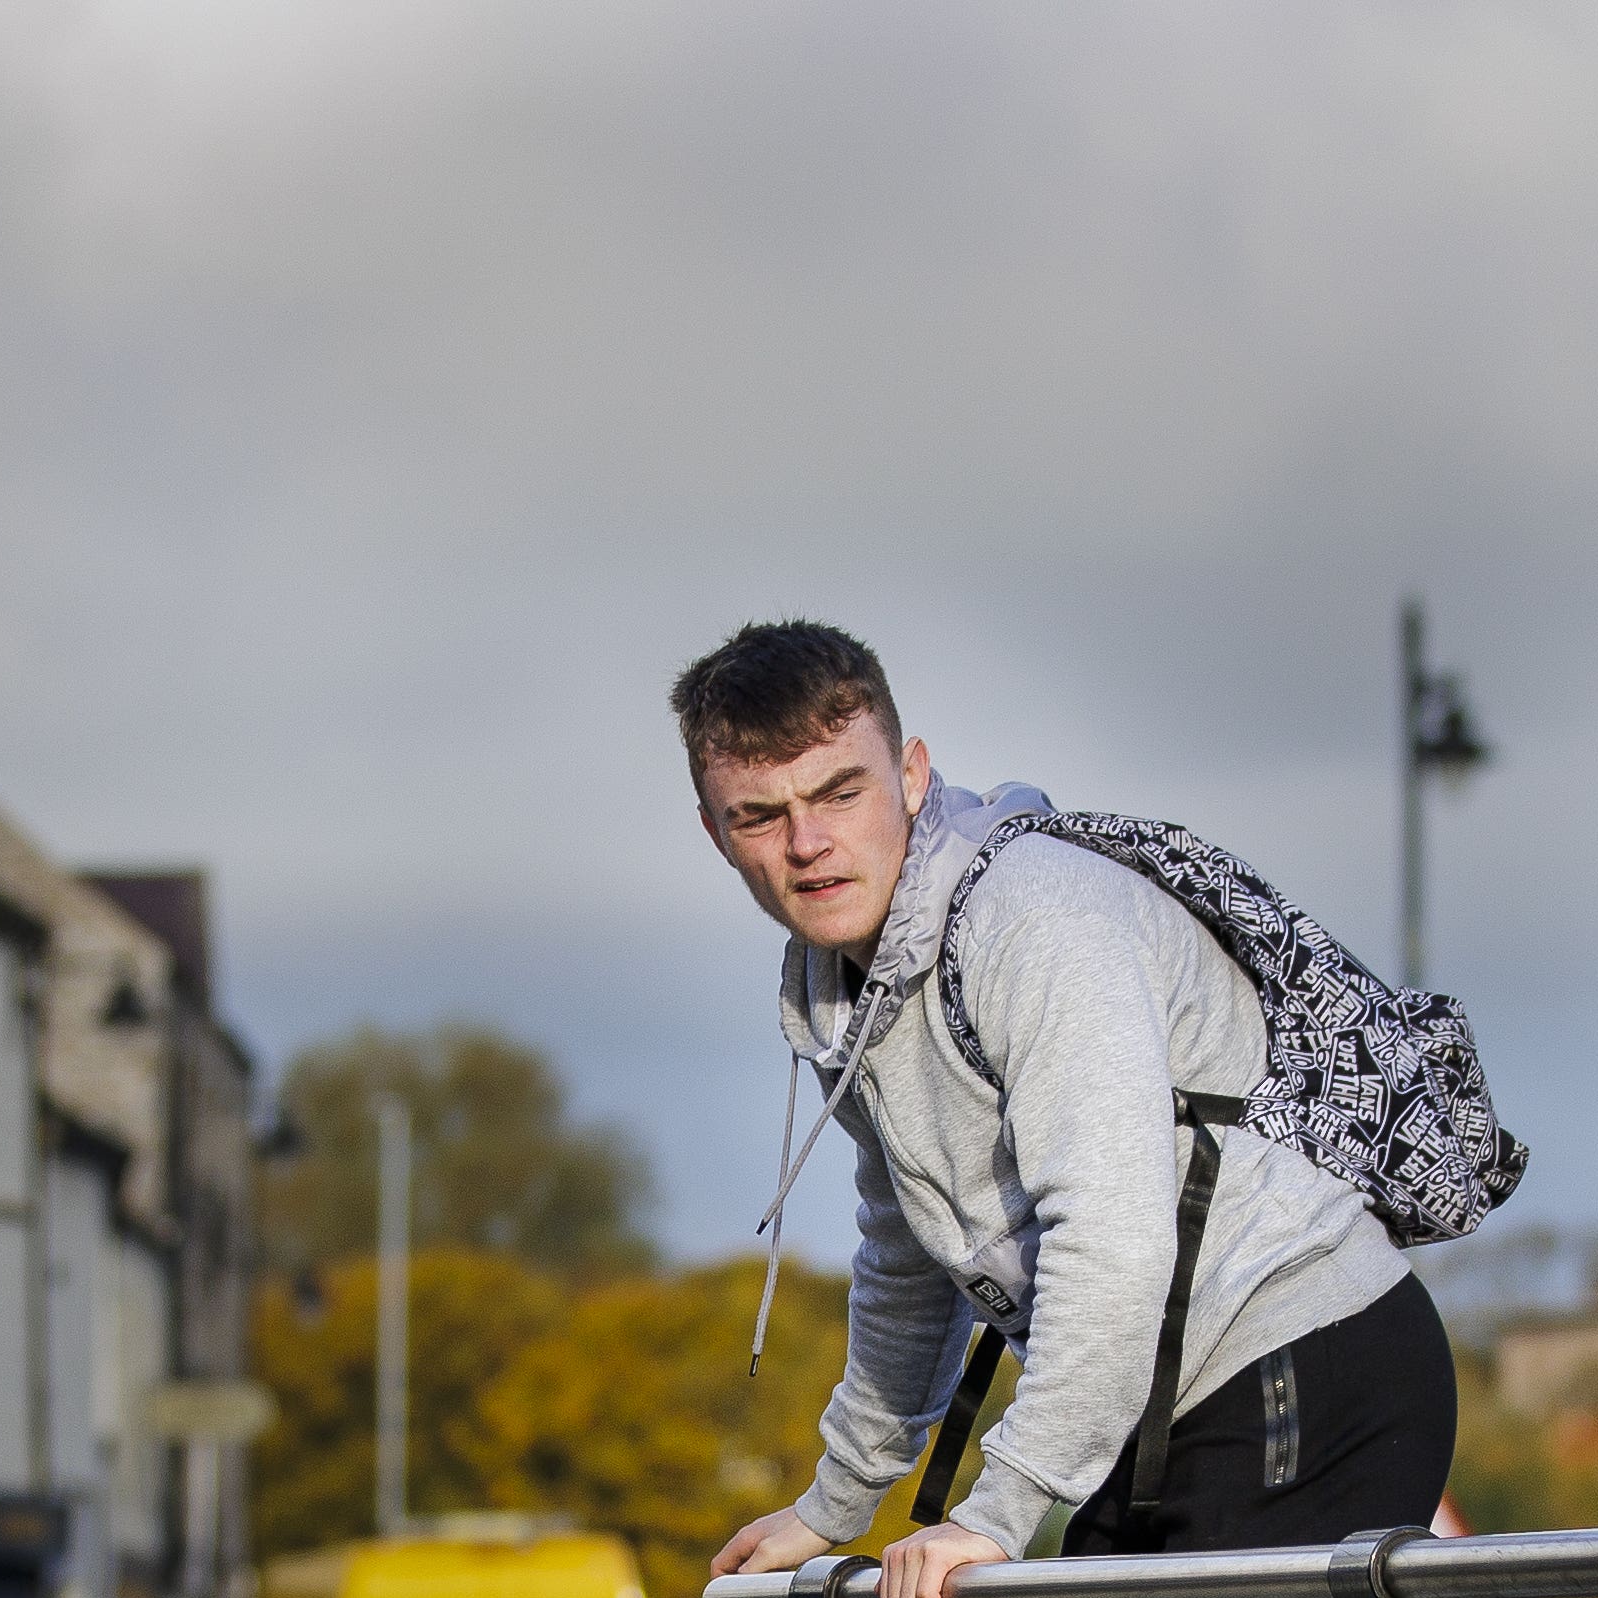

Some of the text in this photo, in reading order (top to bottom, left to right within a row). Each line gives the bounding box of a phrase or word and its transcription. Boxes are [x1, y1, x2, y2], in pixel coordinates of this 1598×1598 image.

[1329, 1074, 1359, 1112] THE
[1357, 1074, 1383, 1124] VANS
[1306, 1111, 1337, 1145] THE
[1309, 1098, 1352, 1133] VANS
[1394, 1099, 1436, 1147] VANS
[1465, 1106, 1488, 1138] THE
[1393, 1149, 1430, 1180] "OFF
[1421, 1188, 1464, 1227] THE
